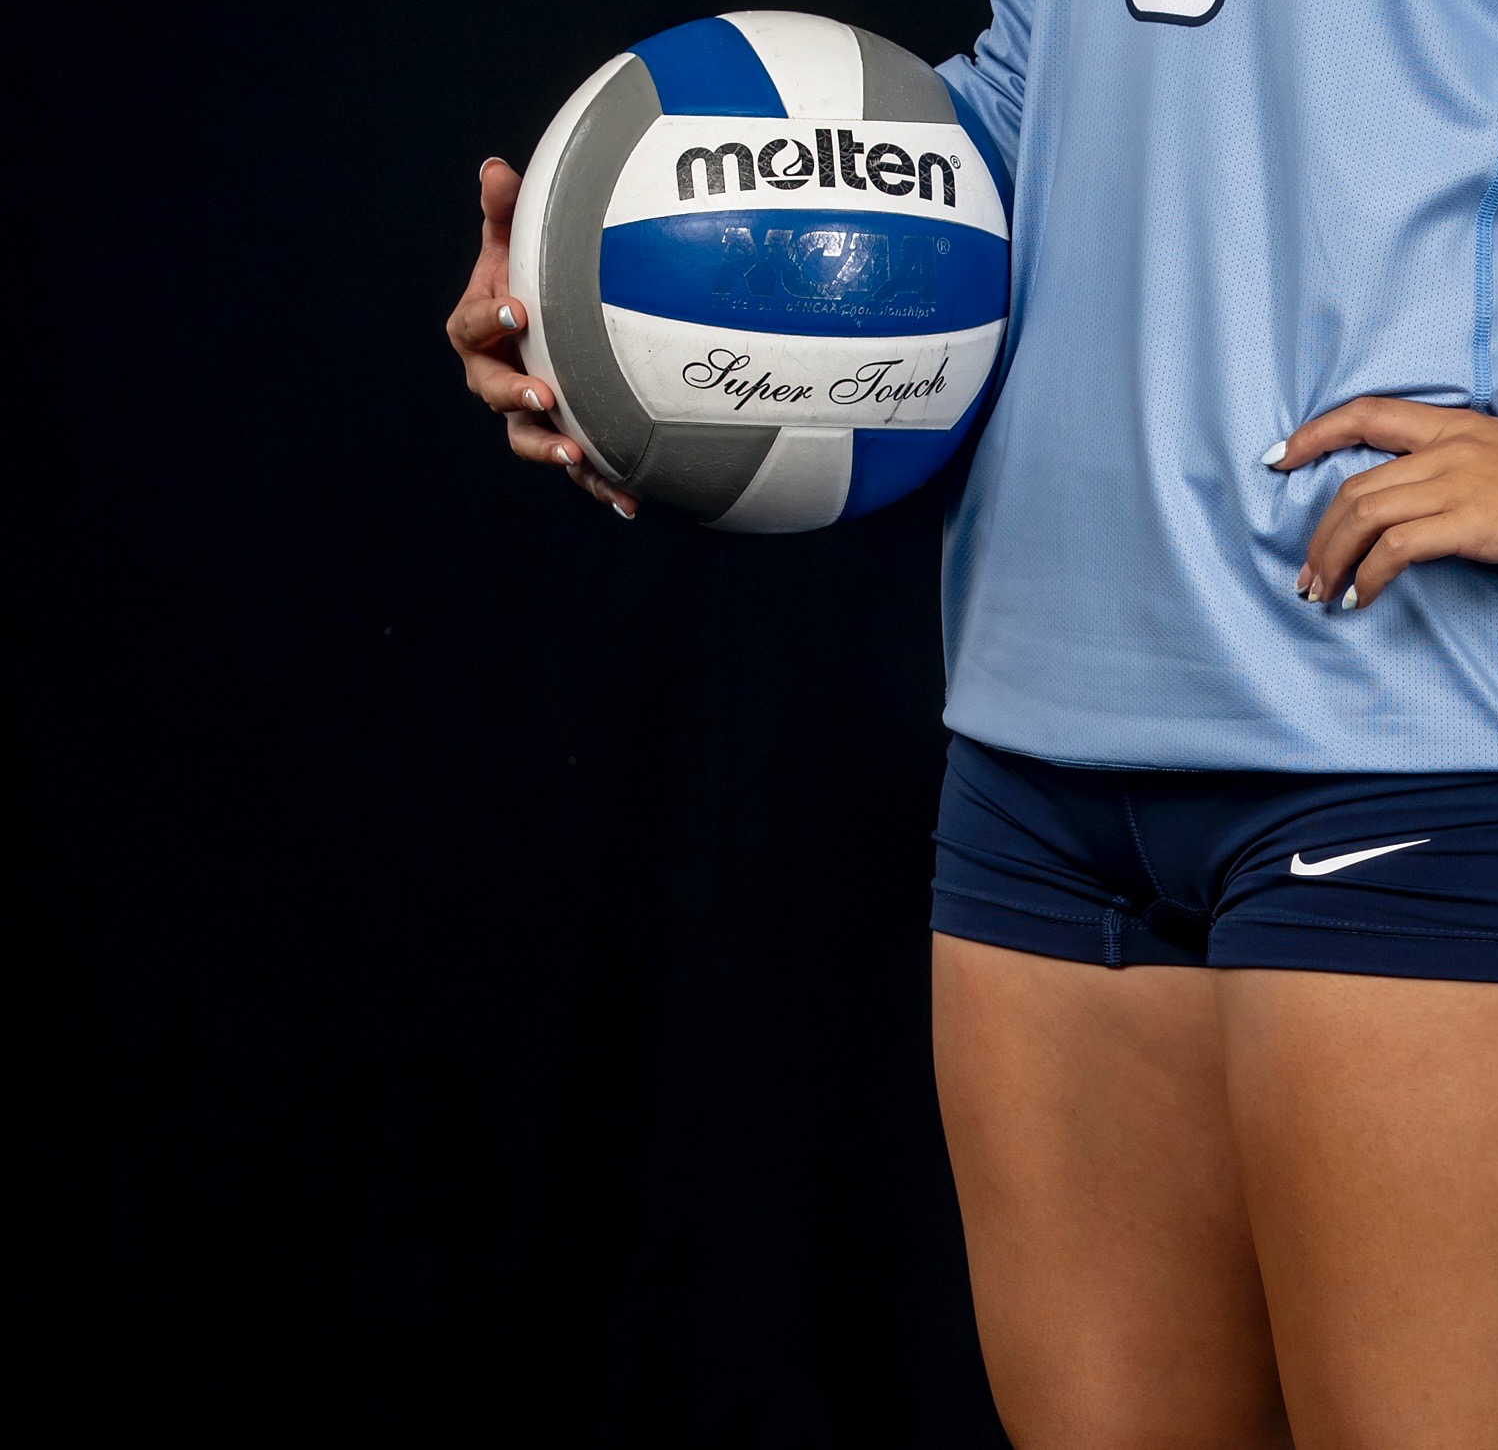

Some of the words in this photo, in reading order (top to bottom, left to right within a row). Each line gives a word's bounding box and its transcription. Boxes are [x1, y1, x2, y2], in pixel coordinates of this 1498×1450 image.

[802, 301, 837, 314] NCAA
[682, 348, 812, 411] Super
[828, 357, 949, 404] Touch
